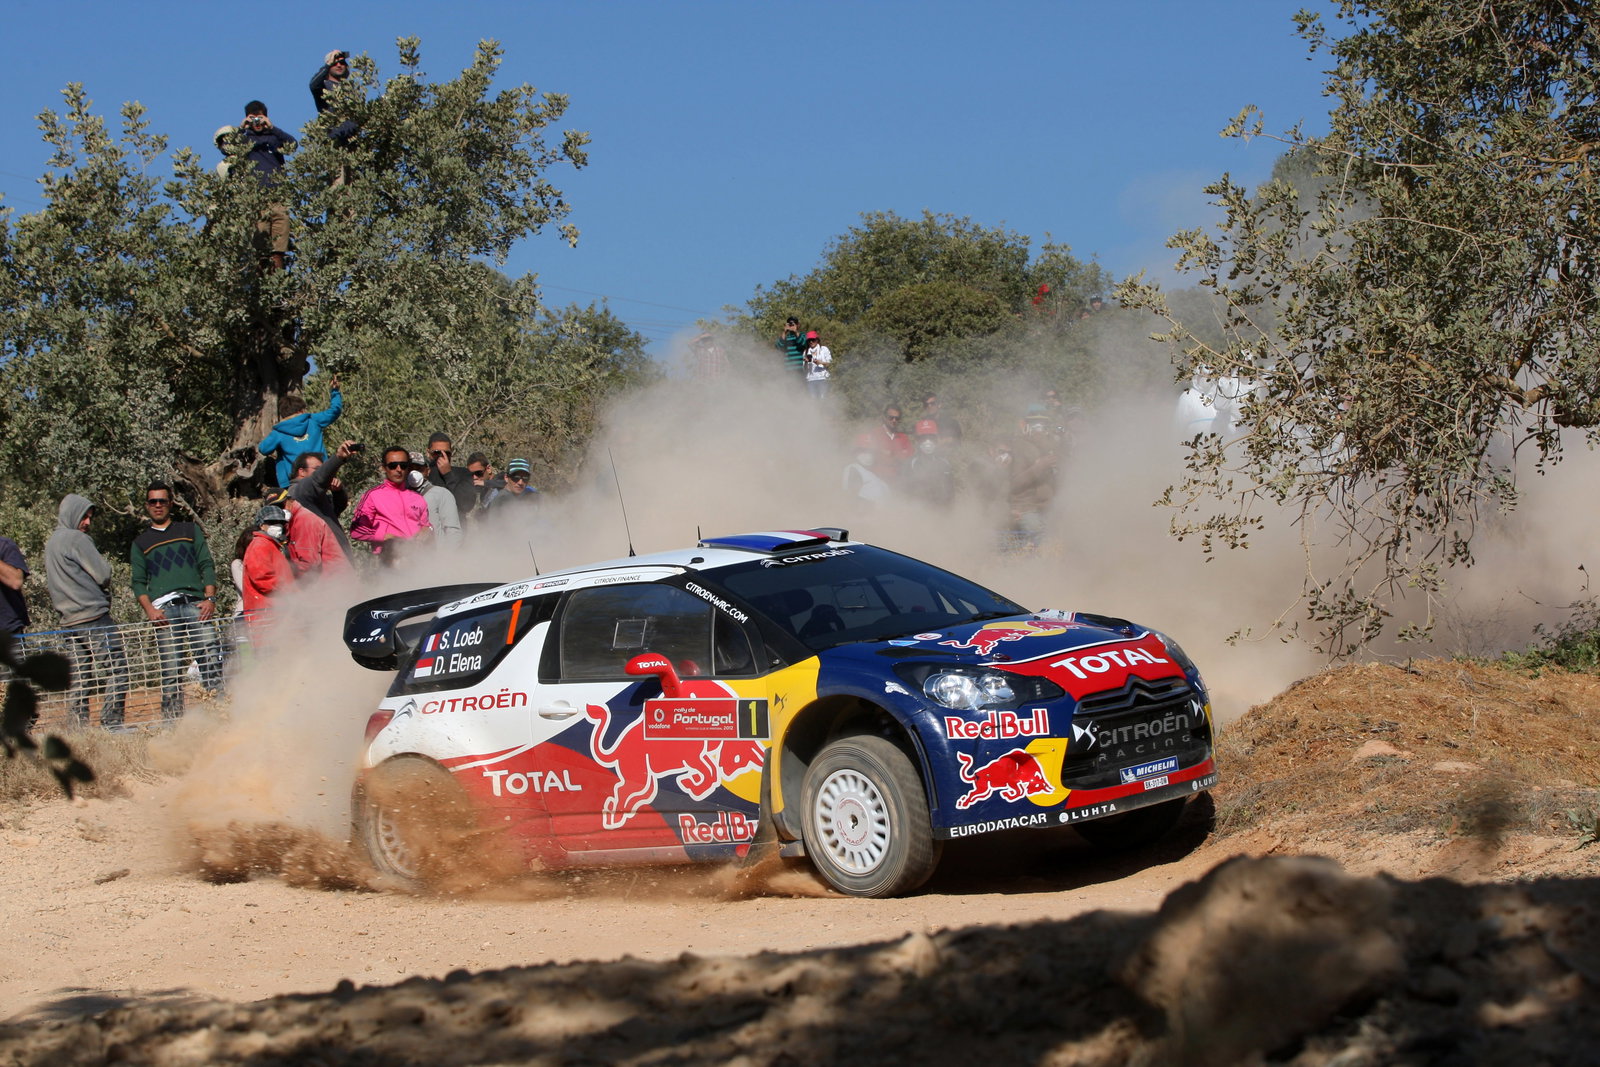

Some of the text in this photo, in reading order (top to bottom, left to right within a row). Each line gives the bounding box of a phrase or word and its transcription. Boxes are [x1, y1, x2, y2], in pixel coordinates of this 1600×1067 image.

[782, 547, 855, 563] CITROËN
[686, 582, 748, 624] CITROEN-WRC.COM
[506, 599, 523, 645] 1
[440, 626, 483, 650] S. Loeb
[434, 653, 482, 675] D. Elena
[637, 660, 667, 669] TOTAL
[1050, 647, 1168, 680] TOTAL
[421, 688, 528, 715] CITROËN
[673, 713, 735, 727] Portugal
[748, 701, 758, 736] 1
[944, 712, 999, 740] Red
[1000, 708, 1050, 738] Bull
[1098, 712, 1189, 748] CITROËN
[1098, 734, 1191, 762] RACING
[1136, 760, 1176, 777] MICHELIN
[483, 769, 582, 797] TOTAL
[1071, 803, 1117, 820] LUHTA
[679, 811, 731, 844] Red
[950, 813, 1047, 838] EURODATACAR
